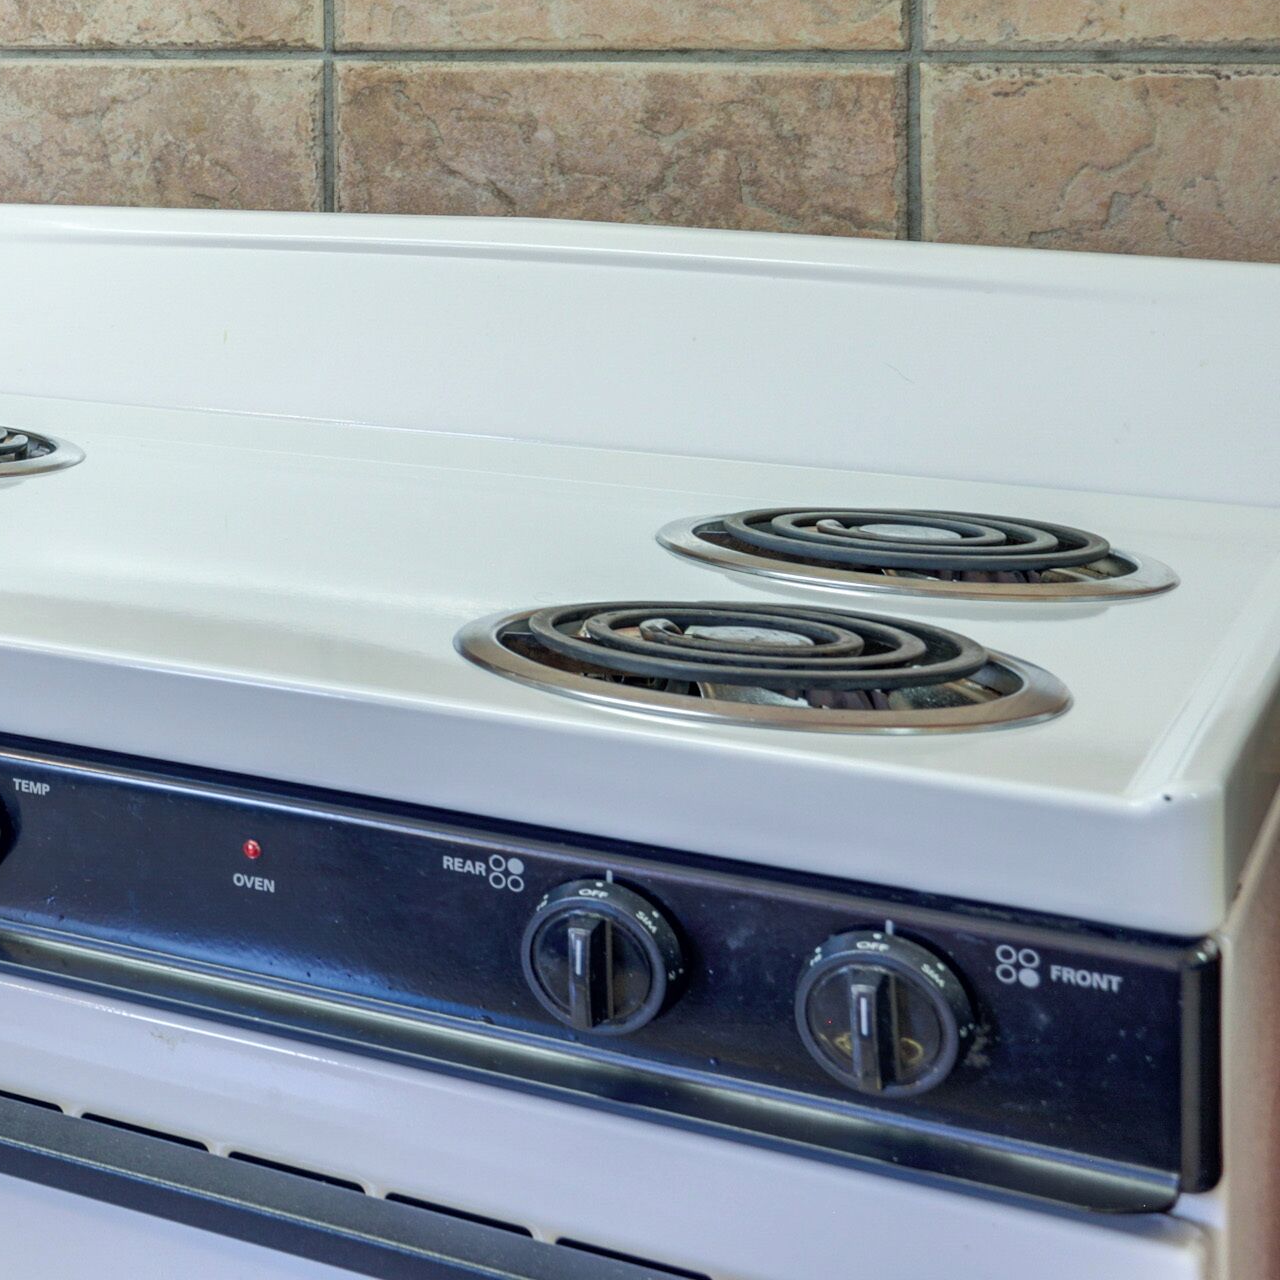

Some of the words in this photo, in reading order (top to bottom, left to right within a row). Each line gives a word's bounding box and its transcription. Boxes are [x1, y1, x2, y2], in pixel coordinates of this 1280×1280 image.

[12, 777, 51, 797] TEMP
[442, 854, 487, 877] REAR
[232, 872, 276, 893] OVEN
[578, 887, 609, 899] OFF
[635, 910, 658, 934] SIM
[856, 940, 890, 952] OFF
[1049, 964, 1124, 993] FRONT
